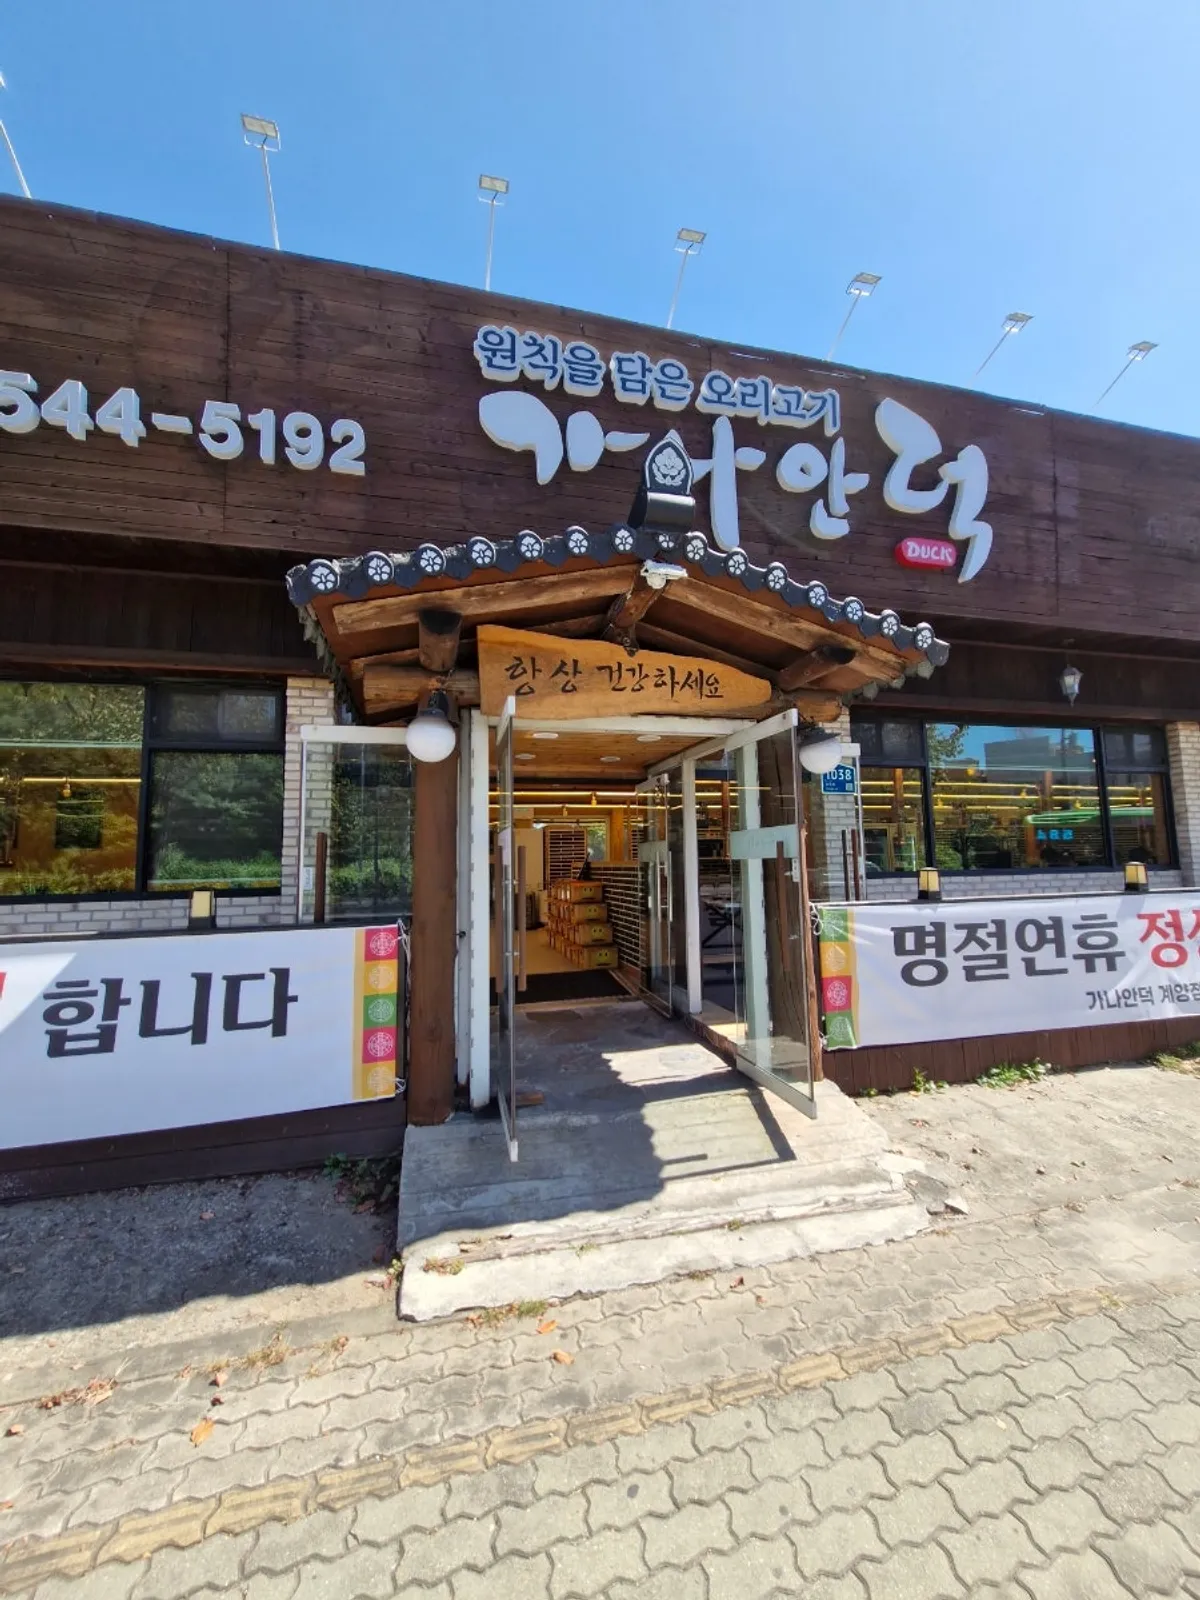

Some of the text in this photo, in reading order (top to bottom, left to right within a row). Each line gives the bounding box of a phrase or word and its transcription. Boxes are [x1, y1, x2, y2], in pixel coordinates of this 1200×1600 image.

[475, 325, 841, 437] 원칙을 담은 오리고기
[0, 369, 366, 476] 544-5192
[907, 541, 953, 563] DUCK
[597, 661, 724, 700] 건강하세요
[825, 769, 852, 781] 1038
[890, 913, 1126, 987] 명절연휴
[42, 967, 299, 1060] 합니다
[1086, 986, 1155, 1010] 가나안덕
